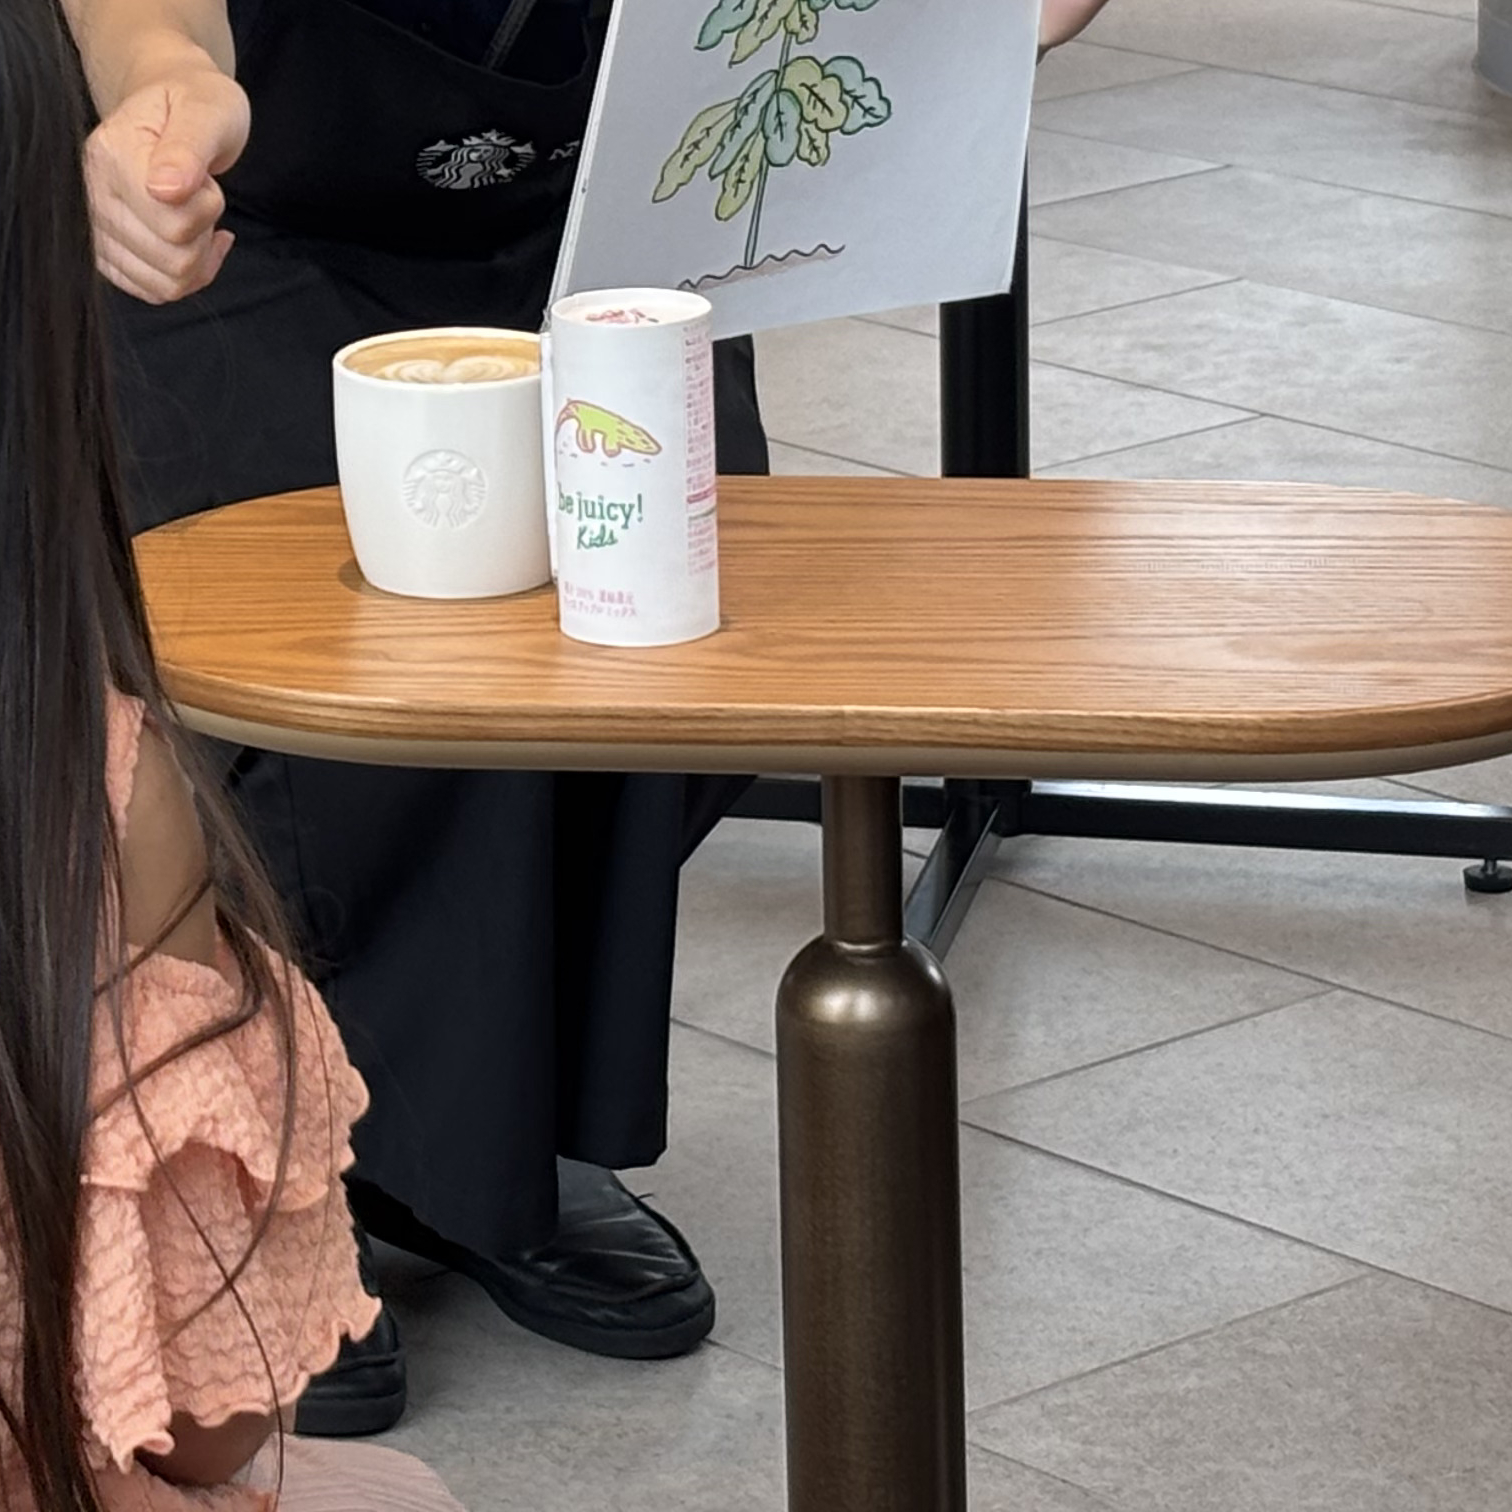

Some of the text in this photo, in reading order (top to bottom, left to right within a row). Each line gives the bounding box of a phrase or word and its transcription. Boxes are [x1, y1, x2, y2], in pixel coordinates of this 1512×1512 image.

[557, 481, 643, 529] be juicy!
[576, 523, 618, 550] Kids
